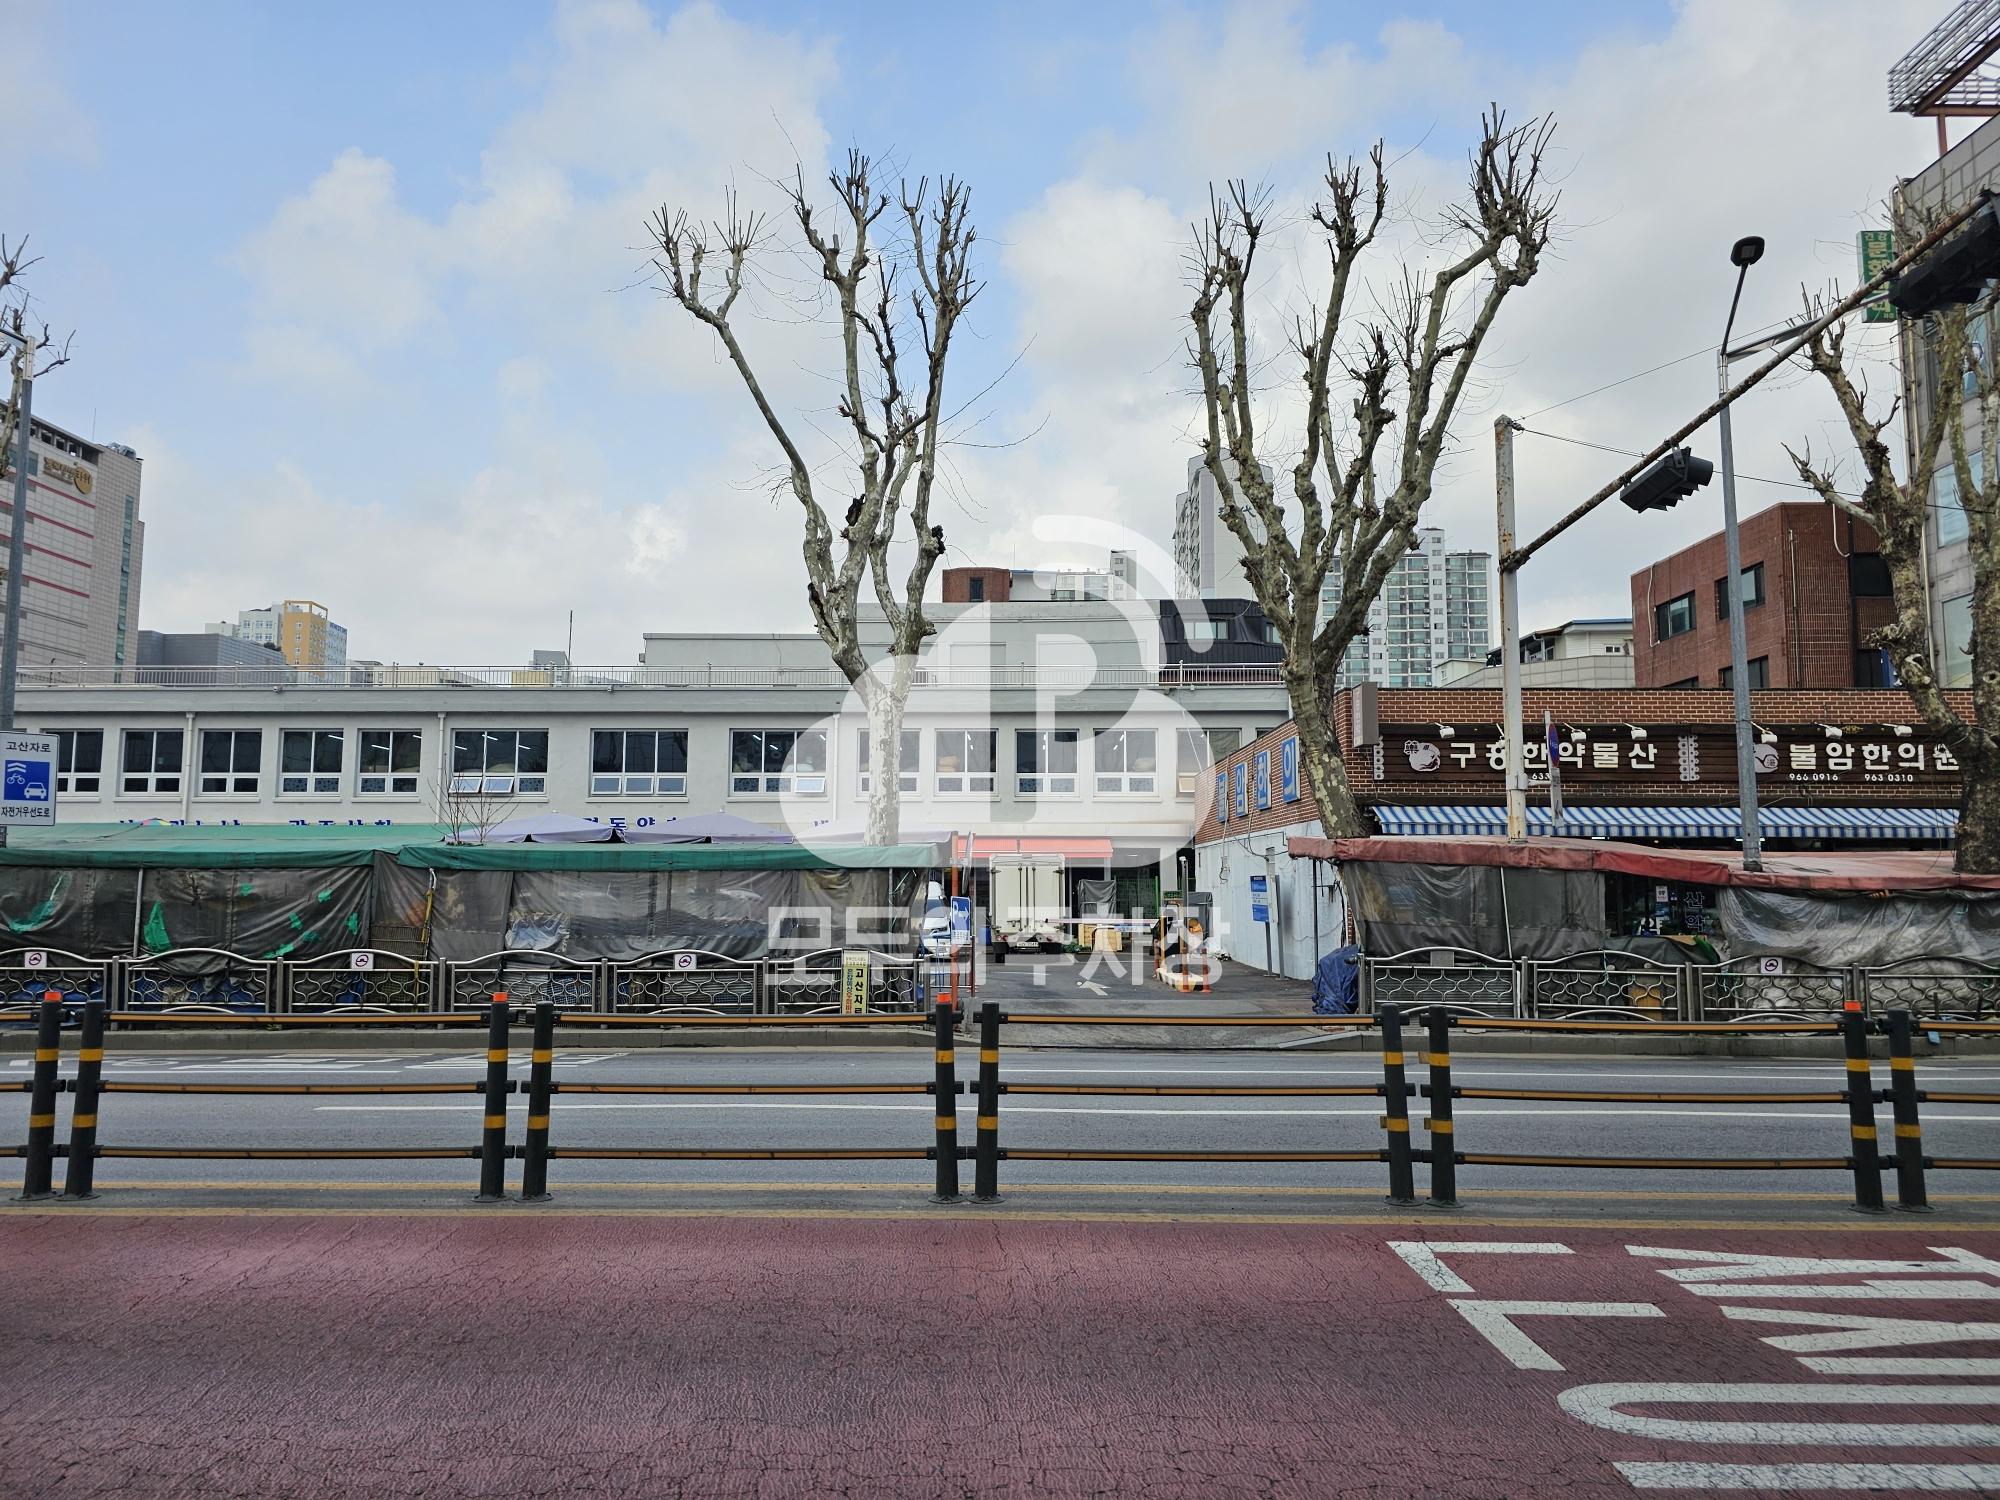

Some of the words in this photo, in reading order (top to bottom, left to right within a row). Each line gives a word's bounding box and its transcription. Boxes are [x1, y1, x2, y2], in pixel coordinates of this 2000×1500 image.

[5, 741, 52, 753] 고산자로
[1788, 742, 1960, 771] 불암한의원
[1812, 773, 1839, 781] 0916
[1864, 773, 1884, 782] 963
[1888, 774, 1914, 782] 0310
[1, 806, 51, 818] 자전거우선도로
